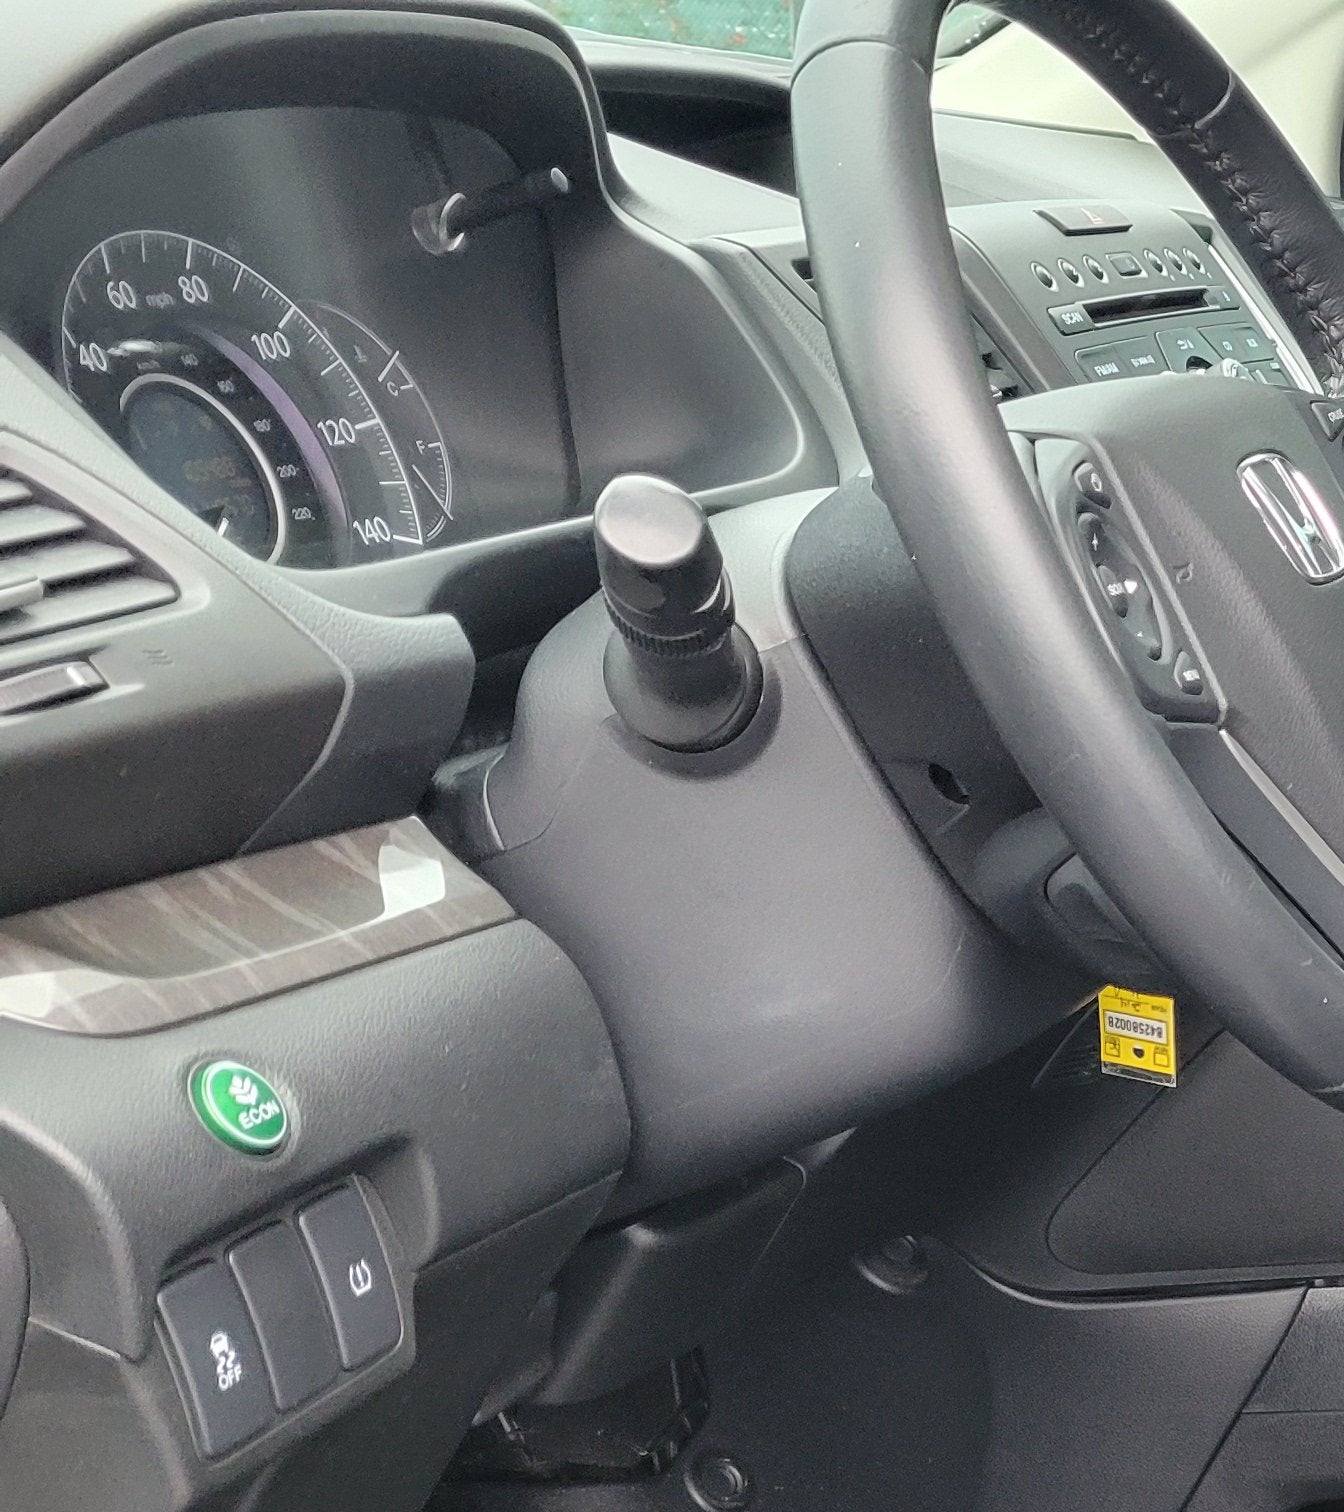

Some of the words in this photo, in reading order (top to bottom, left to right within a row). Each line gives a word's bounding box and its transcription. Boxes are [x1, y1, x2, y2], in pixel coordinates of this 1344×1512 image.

[107, 281, 137, 310] 60
[178, 275, 209, 303] 80
[1061, 312, 1084, 325] SCAN
[80, 343, 107, 371] 40
[251, 331, 291, 360] 100
[317, 418, 356, 446] 120
[416, 440, 426, 454] F
[292, 506, 312, 520] 220
[353, 516, 391, 545] 140
[238, 1099, 280, 1130] ECON
[219, 1364, 242, 1391] OFF
